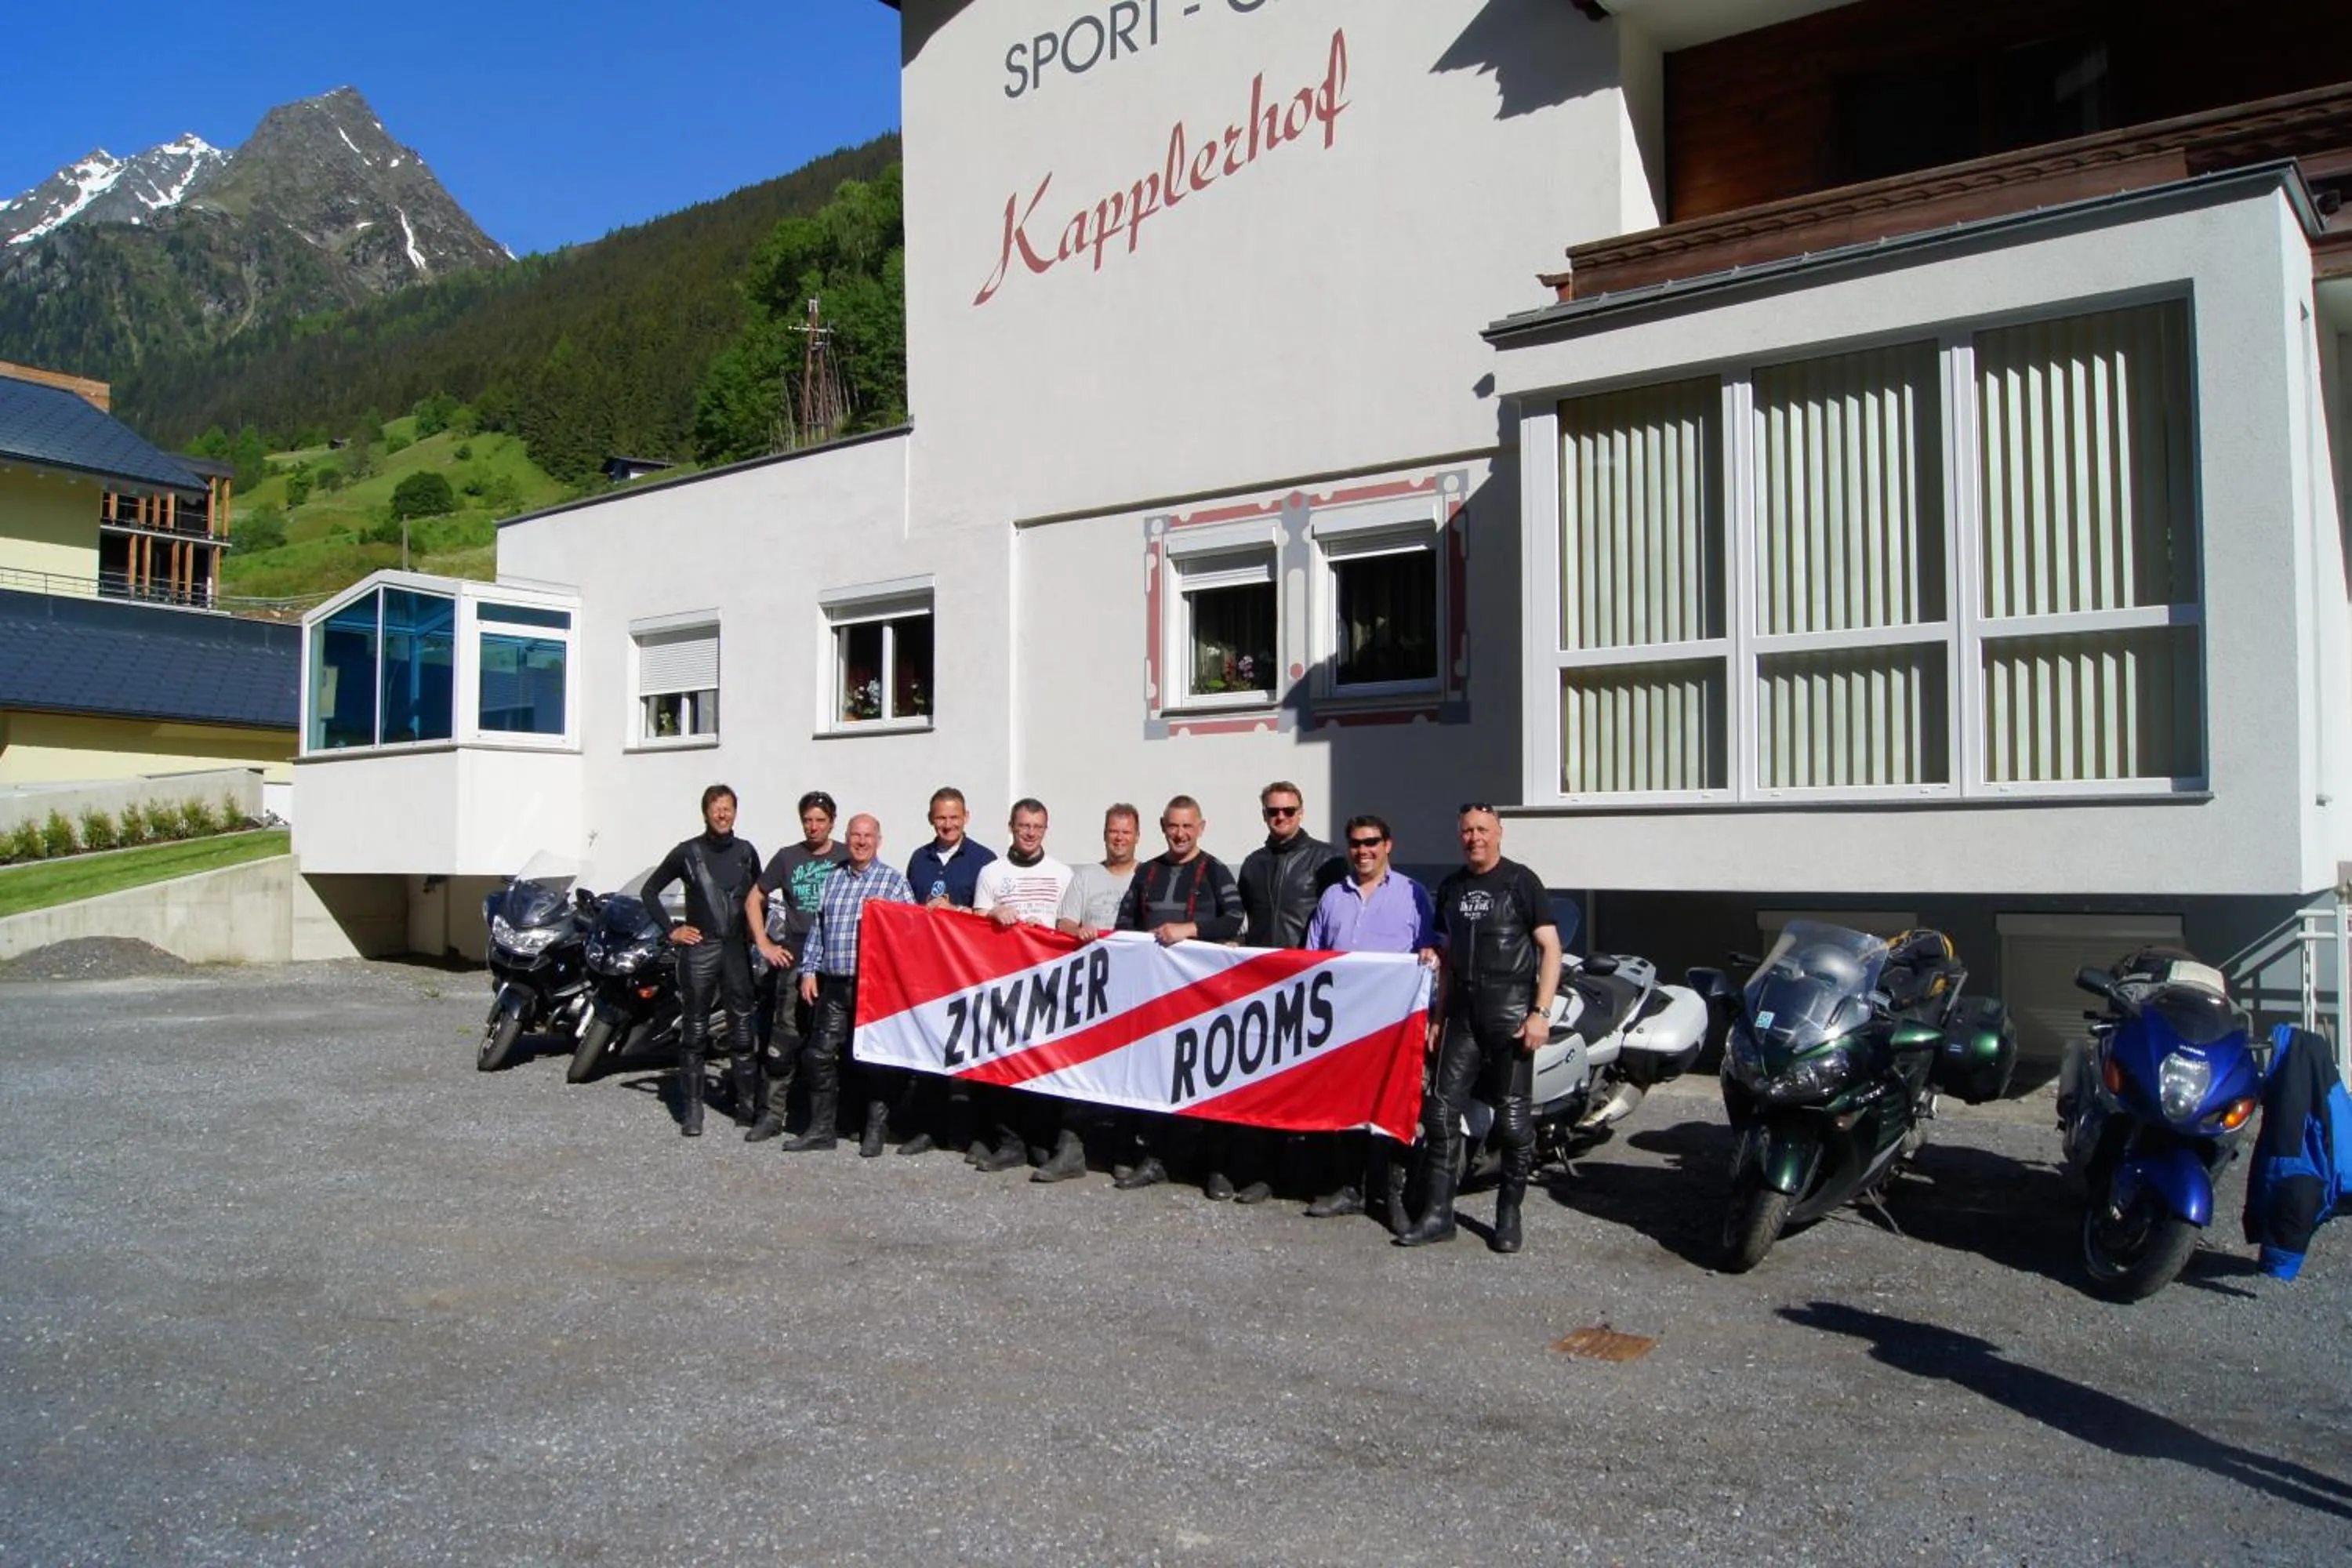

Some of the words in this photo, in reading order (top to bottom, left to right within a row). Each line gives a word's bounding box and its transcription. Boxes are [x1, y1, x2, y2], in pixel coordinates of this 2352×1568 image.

[974, 27, 1352, 306] Kapplerhof
[944, 947, 1109, 1068] ZIMMER
[1171, 970, 1334, 1105] ROOMS
